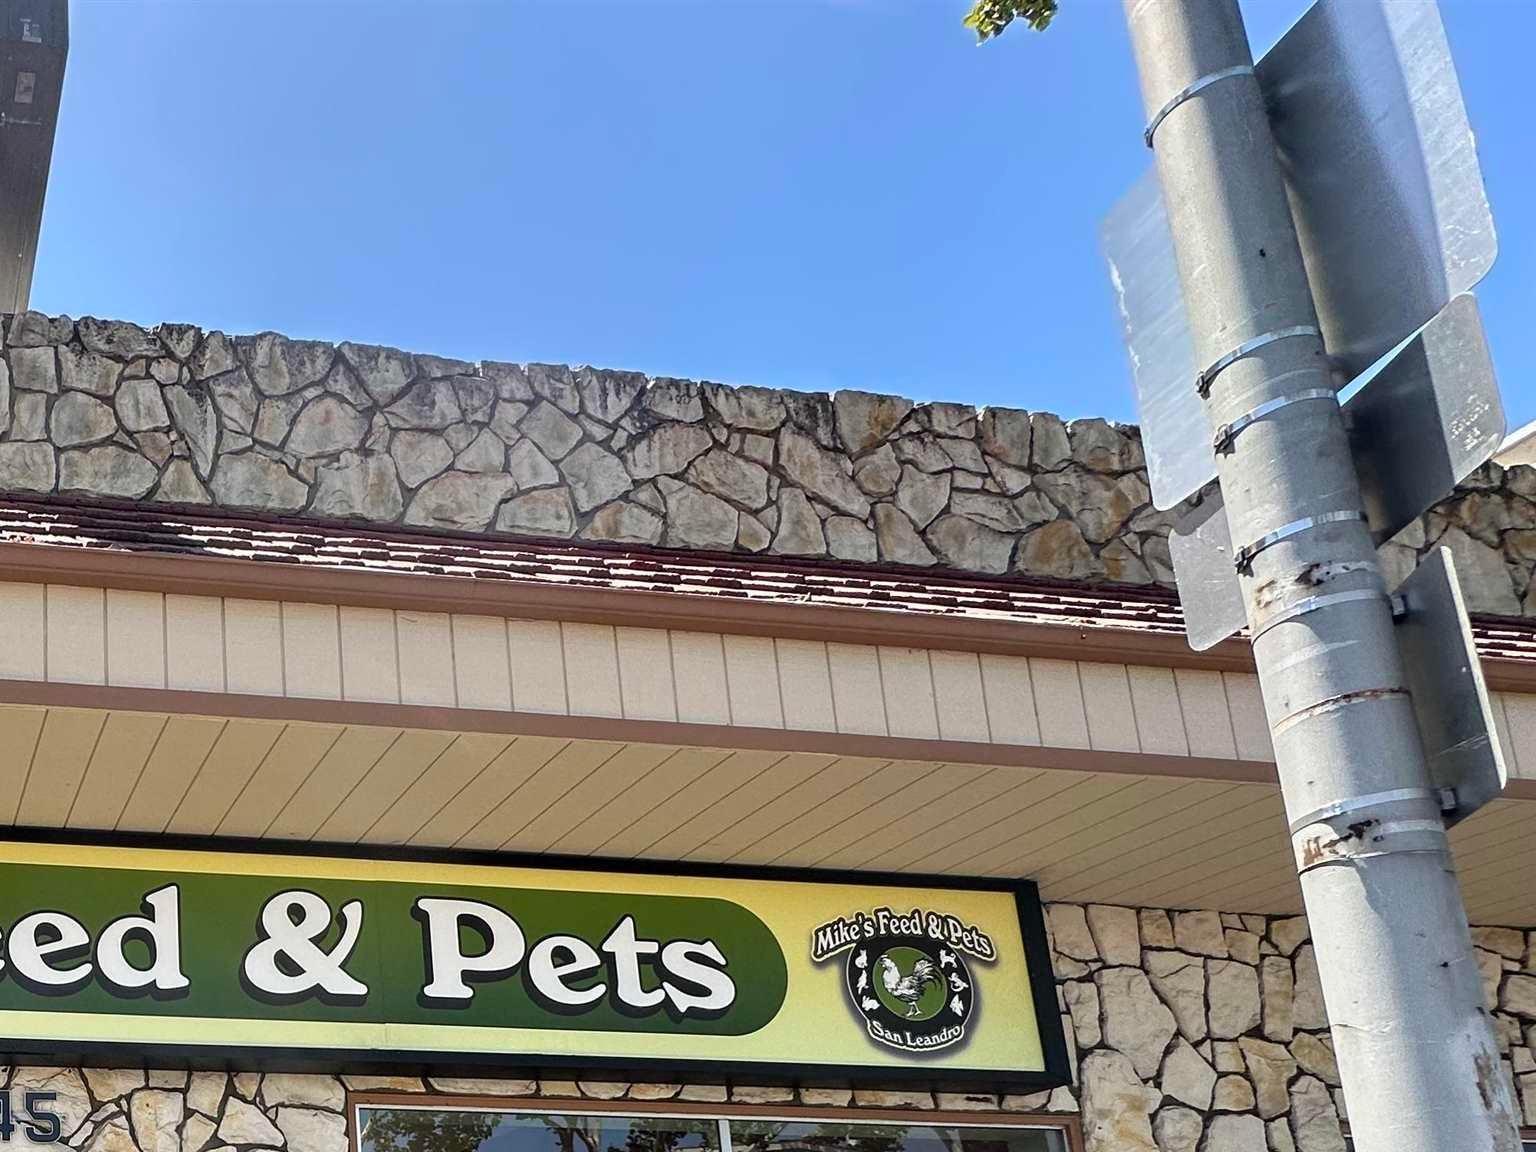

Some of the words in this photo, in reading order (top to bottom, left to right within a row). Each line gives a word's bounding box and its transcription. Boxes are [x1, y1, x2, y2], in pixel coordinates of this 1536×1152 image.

[243, 889, 369, 997] &
[414, 896, 737, 1014] Pets
[815, 915, 875, 956] Mike's
[877, 910, 923, 936] Feed
[927, 914, 948, 941] &
[947, 916, 992, 955] Pets
[872, 1019, 904, 1044] San
[907, 1024, 962, 1047] Leandro
